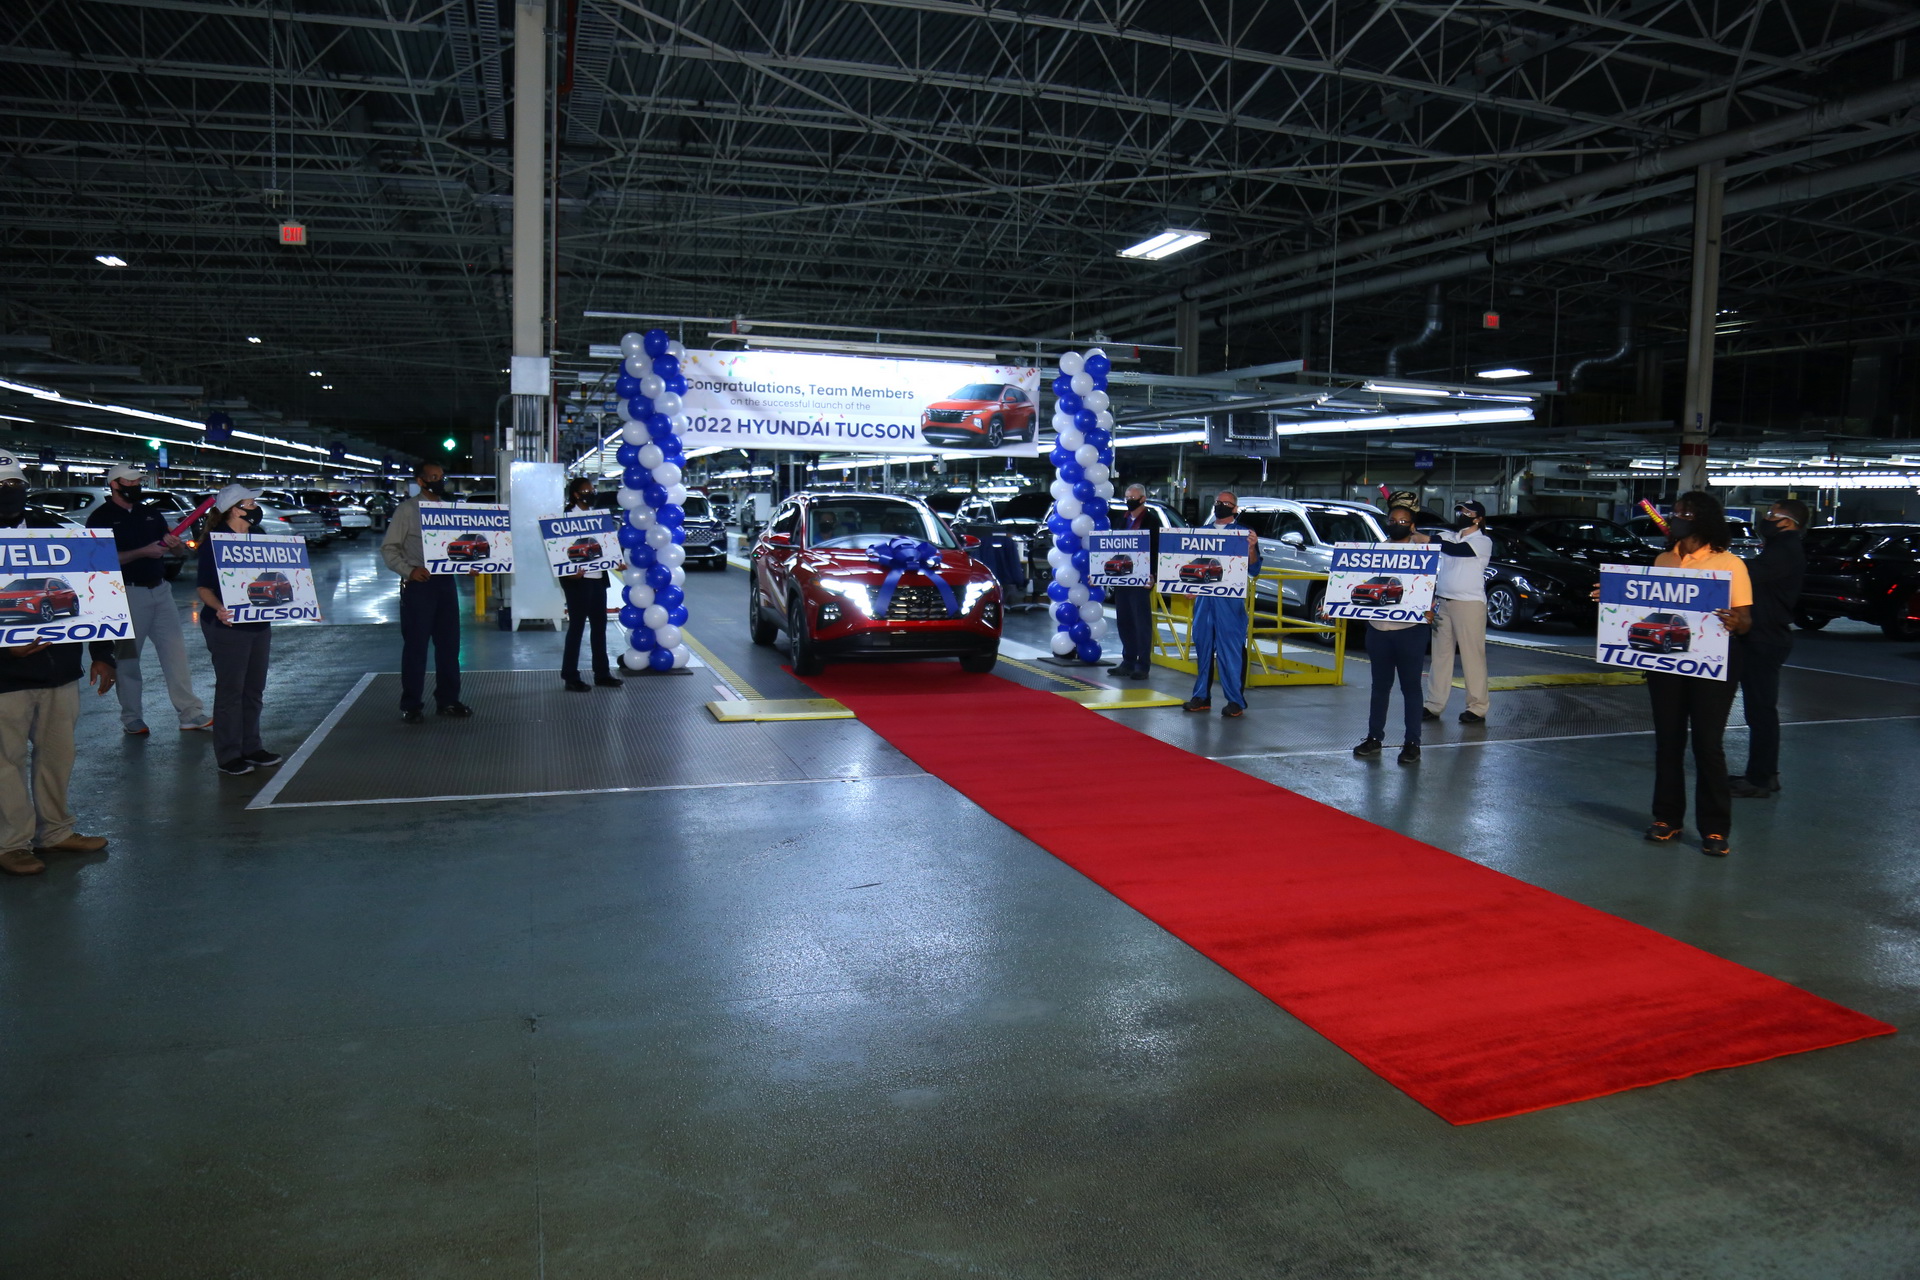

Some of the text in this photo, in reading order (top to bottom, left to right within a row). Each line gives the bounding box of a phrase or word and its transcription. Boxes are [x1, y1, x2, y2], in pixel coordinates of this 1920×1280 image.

[283, 227, 303, 241] EXIT
[686, 378, 914, 399] Congratulations, Team Members
[730, 397, 871, 410] on the successful launch of the
[686, 416, 915, 439] 2022 HYUNDAI TUCSON
[421, 514, 510, 527] MAINTENANCE
[551, 518, 603, 536] QUALITY
[1100, 537, 1139, 550] ENGINE
[1181, 537, 1226, 551] PAINT
[0, 544, 72, 567] ELD
[221, 545, 302, 564] ASSEMBLY
[1336, 552, 1433, 570] ASSEMBLY
[427, 558, 512, 573] TUCSON
[1091, 573, 1148, 586] TUCSON
[1159, 579, 1244, 597] TUCSON
[1625, 579, 1700, 604] STAMP
[227, 603, 317, 622] TUCSON
[1326, 602, 1425, 622] TUCSON
[0, 622, 128, 644] CSON
[1600, 643, 1723, 678] TUCSON
